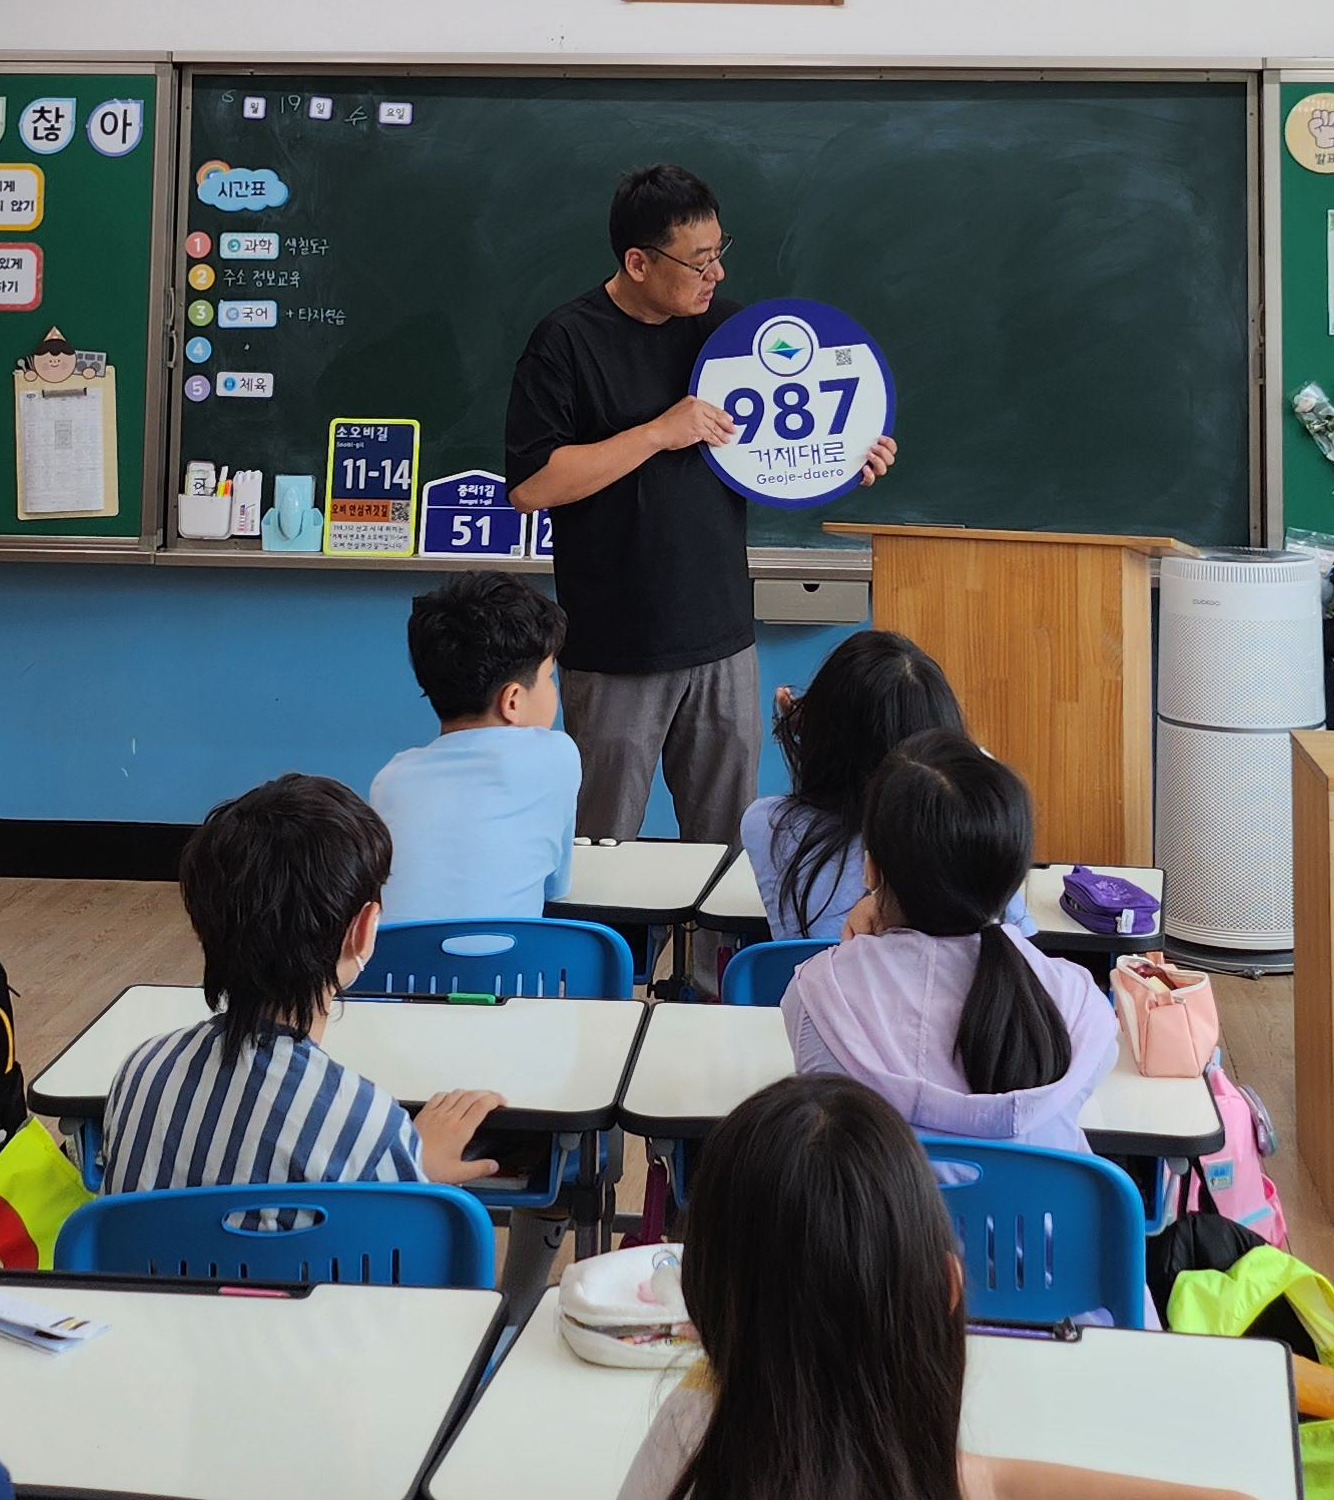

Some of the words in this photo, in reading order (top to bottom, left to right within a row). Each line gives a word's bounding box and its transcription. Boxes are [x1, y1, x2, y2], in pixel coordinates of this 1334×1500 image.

[279, 95, 302, 114] 19
[315, 102, 327, 114] 일
[344, 106, 369, 126] 수
[385, 106, 406, 120] 요일
[217, 180, 267, 199] 시간표
[10, 198, 35, 213] 않기
[193, 238, 202, 252] 1
[243, 238, 273, 253] 과학
[284, 236, 330, 257] 색칠도구
[196, 269, 208, 285] 2
[222, 269, 247, 287] 주소
[252, 269, 301, 288] 정보교육
[195, 305, 207, 320] 3
[241, 307, 269, 321] 국어
[192, 342, 204, 357] 4
[192, 381, 203, 396] 5
[239, 377, 267, 393] 체육
[723, 376, 861, 446] 987
[335, 425, 389, 442] 소오비길
[749, 441, 847, 470] 거제대로
[342, 458, 411, 490] 11-14
[756, 468, 845, 486] Geoje-daero
[457, 484, 496, 498] 중리1길
[332, 503, 347, 515] 오비
[348, 503, 389, 518] 안심귀갓길
[451, 515, 491, 547] 51
